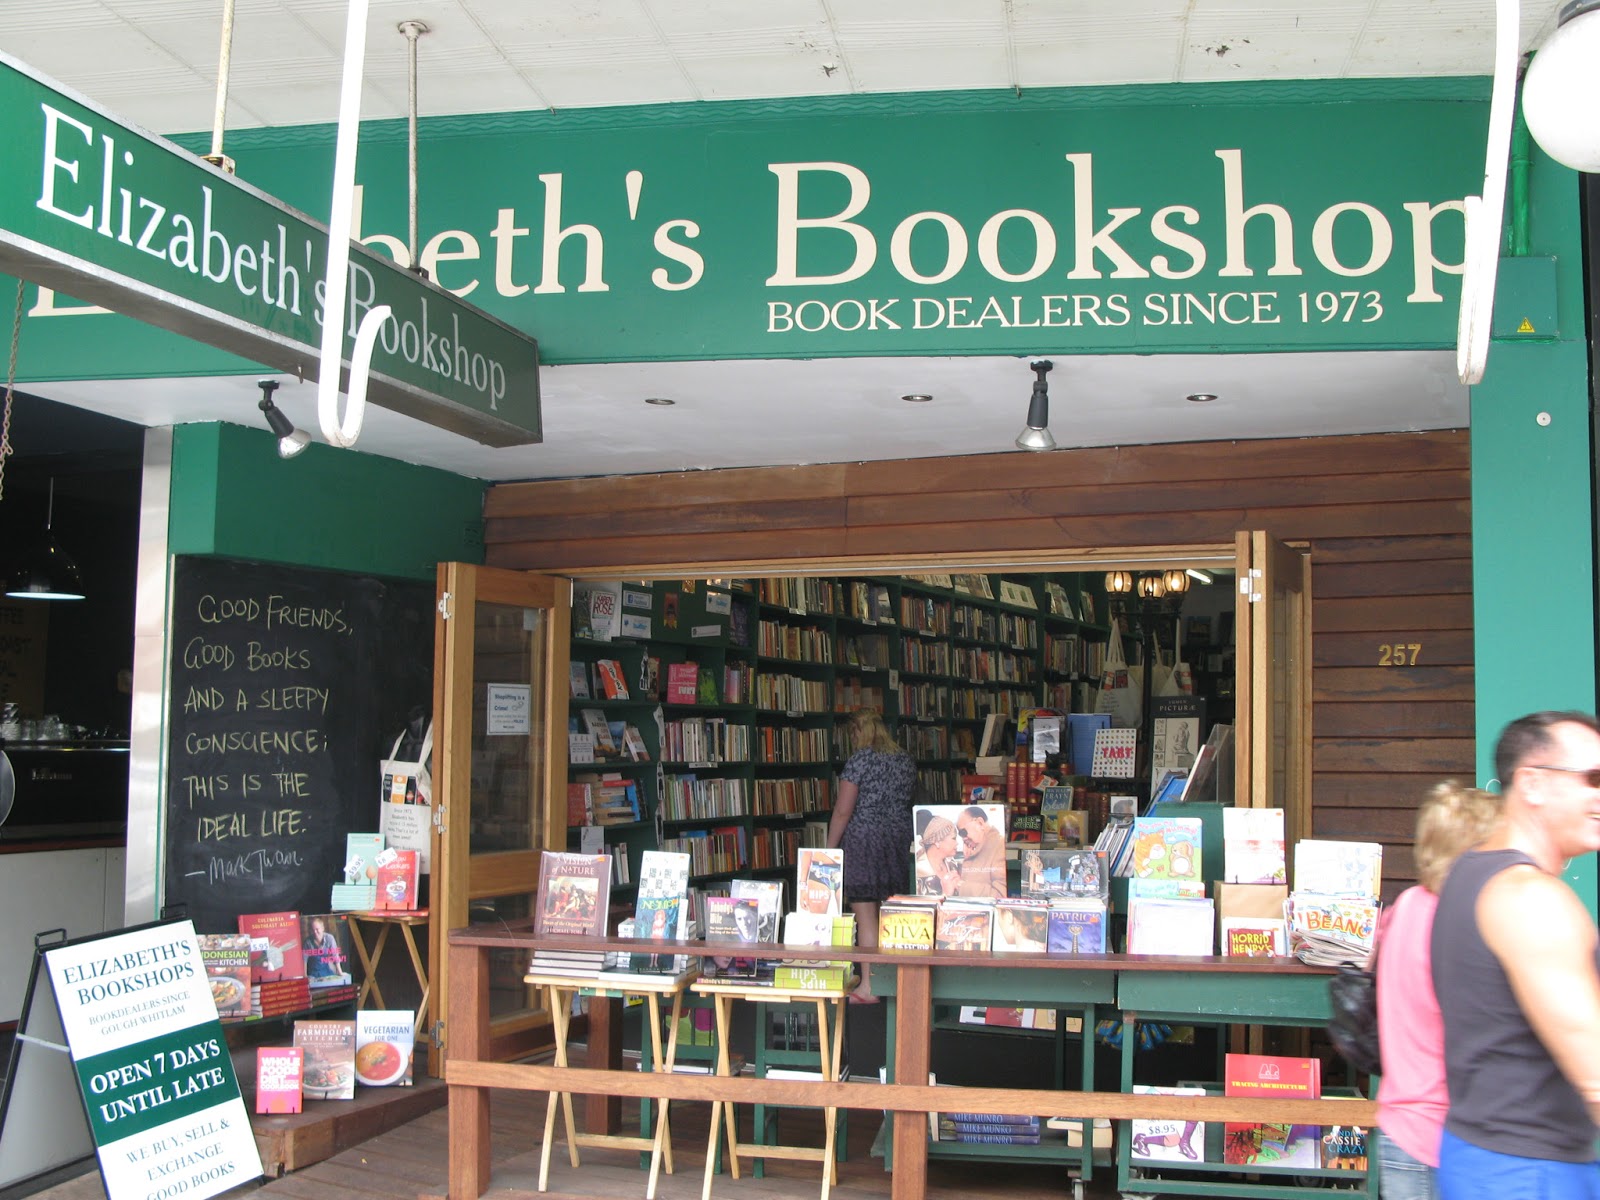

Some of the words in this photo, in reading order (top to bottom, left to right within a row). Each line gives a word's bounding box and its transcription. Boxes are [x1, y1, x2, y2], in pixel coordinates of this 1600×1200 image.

[766, 149, 1467, 304] Bookshop
[36, 103, 328, 326] Elizabeth's
[348, 260, 506, 410] Bookshop
[767, 300, 901, 333] BOOK
[913, 295, 1131, 330] DEALERS
[1143, 291, 1281, 326] SINCE
[1299, 290, 1384, 323] 1973
[199, 595, 260, 623] GOOD
[267, 595, 353, 635] FRIENDS,
[593, 602, 614, 615] ROSE
[184, 637, 235, 671] GOOD
[1378, 643, 1422, 666] 257
[184, 686, 225, 714] AND
[237, 688, 249, 711] A
[256, 686, 329, 715] SLEEPY
[182, 773, 229, 810] THIS
[243, 774, 261, 797] IS
[271, 771, 310, 797] THE
[197, 810, 250, 843] IDEAL
[563, 856, 592, 866] VISION
[210, 854, 252, 885] Mark
[551, 866, 559, 874] of
[561, 866, 595, 876] NATURE
[809, 889, 829, 900] HIPS
[710, 901, 734, 915] Nobody's
[252, 922, 278, 930] SOUTHEAST
[257, 916, 284, 924] CULINARIA
[1306, 911, 1372, 939] BEANO
[882, 925, 931, 940] SILVA
[63, 939, 191, 984] ELIZABETH'S
[219, 958, 248, 966] KITCHEN
[791, 968, 817, 980] HIPS
[76, 961, 195, 1006] BOOKSHOPS
[800, 979, 827, 990] HIPS
[88, 998, 161, 1026] BOOKDEALERS
[162, 990, 190, 1007] SINCE
[101, 1018, 138, 1036] GOUGH
[139, 1005, 186, 1025] WHITLAM
[297, 1028, 353, 1036] FARMHOUSE
[363, 1025, 410, 1034] VEGETARIAN
[90, 1060, 152, 1095] OPEN
[154, 1053, 166, 1074] 7
[169, 1038, 221, 1070] DAYS
[261, 1056, 300, 1067] WHOLE
[260, 1066, 299, 1076] FOODS
[260, 1075, 286, 1085] DIET
[1231, 1080, 1259, 1088] TRACING
[1260, 1082, 1308, 1091] ARCHITECTURE
[100, 1085, 171, 1123] UNTIL
[172, 1067, 225, 1099] LATE
[954, 1113, 972, 1123] MIKE
[974, 1114, 1003, 1124] MUNRO
[962, 1124, 981, 1133] MIKE
[983, 1124, 1012, 1134] MUNRO
[1148, 1124, 1176, 1135] $8.95
[126, 1147, 150, 1164] WE
[152, 1134, 184, 1155] BUY,
[184, 1121, 218, 1142] SELL
[220, 1117, 230, 1130] &
[963, 1135, 981, 1144] MIKE
[983, 1136, 1012, 1145] MUNRO
[1323, 1135, 1360, 1146] CASSIE
[1328, 1145, 1365, 1155] CRAZY
[147, 1141, 224, 1181] EXCHANGE
[147, 1179, 189, 1200] GOOD
[192, 1160, 236, 1192] BOOKS
